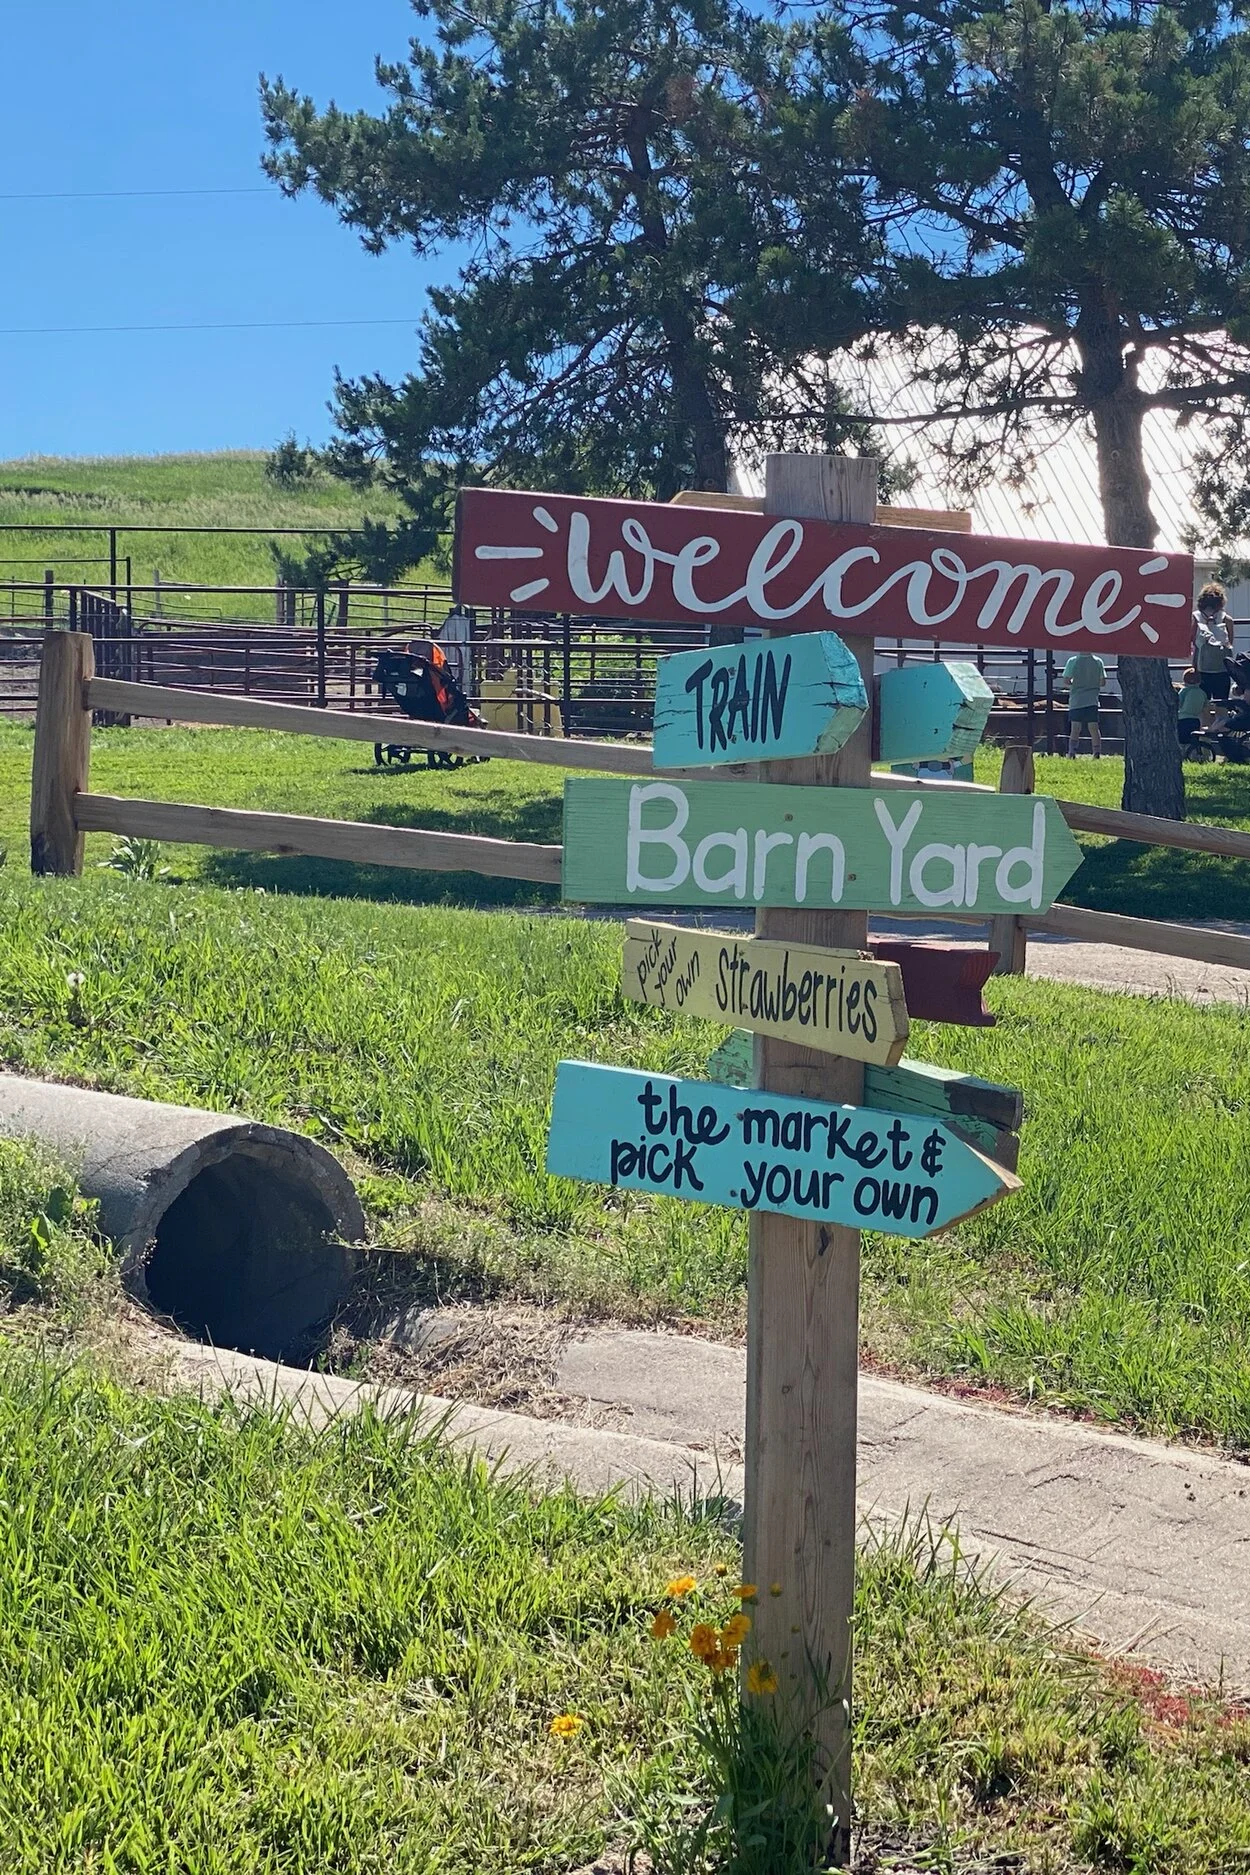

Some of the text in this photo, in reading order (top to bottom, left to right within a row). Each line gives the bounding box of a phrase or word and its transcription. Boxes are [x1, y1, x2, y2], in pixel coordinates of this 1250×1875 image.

[685, 650, 792, 752] TRAIN
[626, 782, 1045, 910] Barn Yard
[636, 928, 663, 1002] pick
[654, 936, 678, 1007] your
[676, 950, 701, 1007] own
[637, 1080, 946, 1178] the market &
[610, 1135, 939, 1226] pick your own
